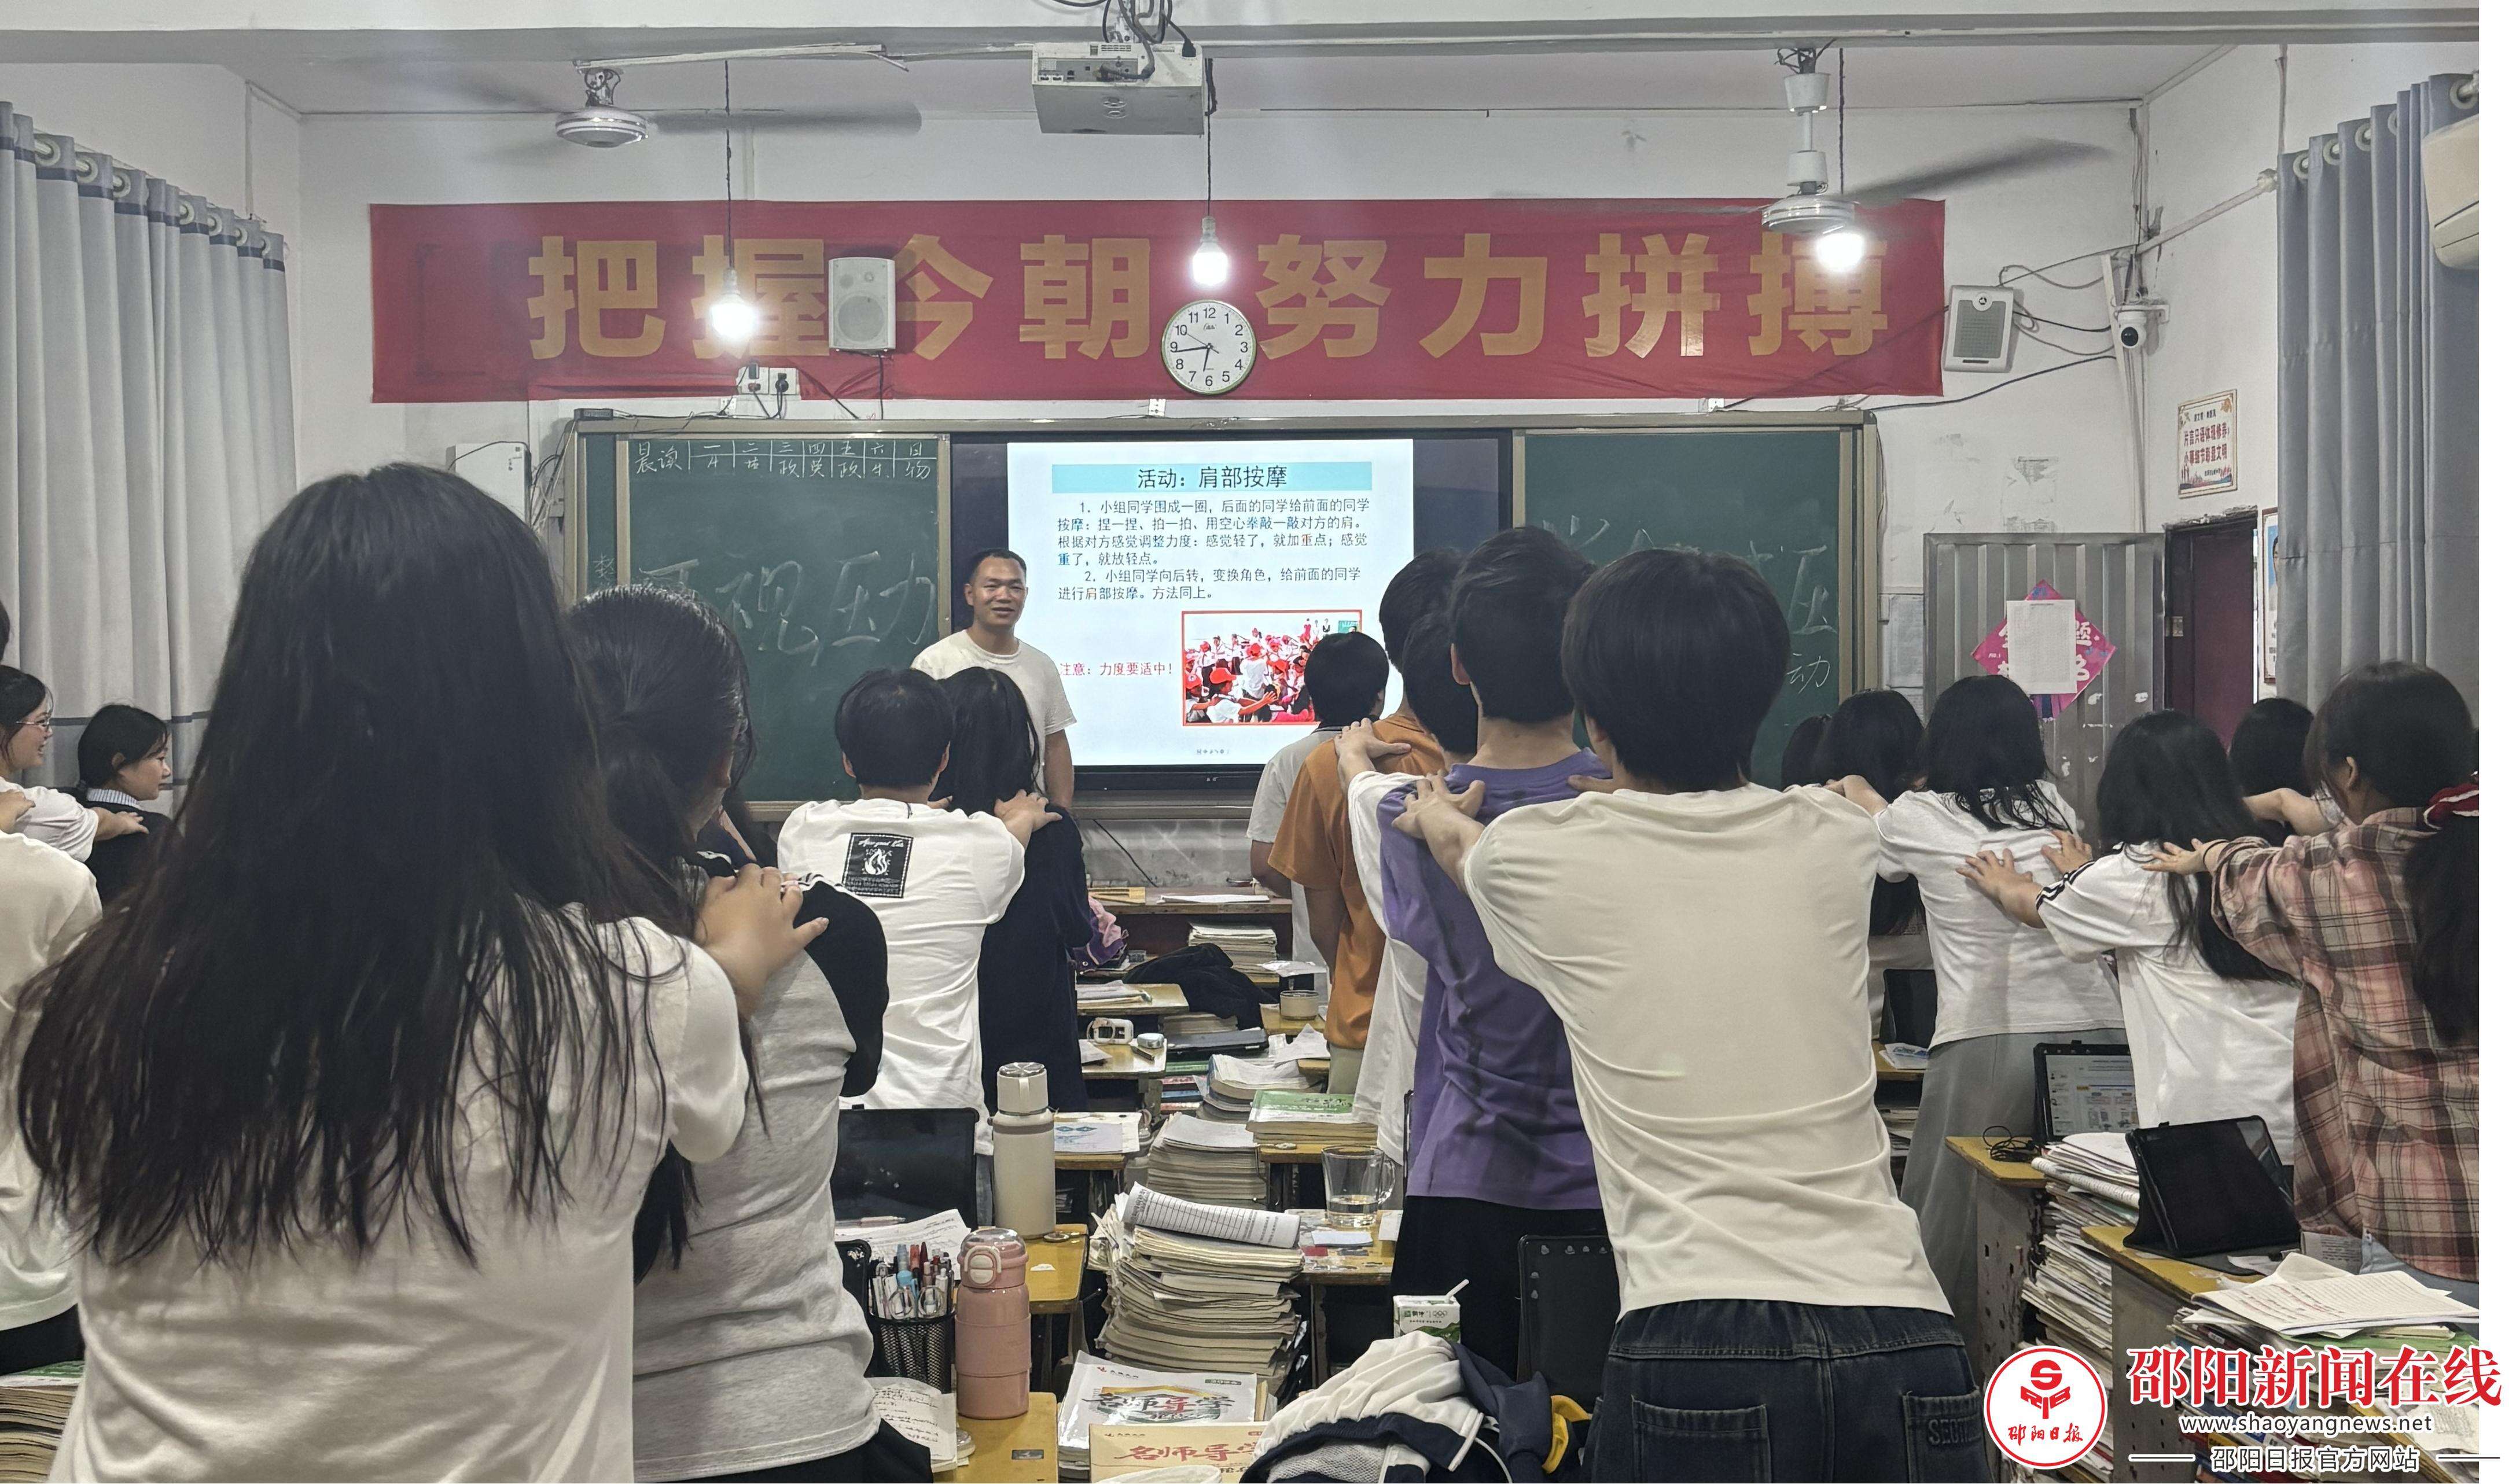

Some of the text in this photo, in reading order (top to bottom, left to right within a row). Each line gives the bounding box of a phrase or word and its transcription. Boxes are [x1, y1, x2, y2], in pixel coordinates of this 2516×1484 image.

[528, 233, 1888, 362] 把握今朝 努力拼搏
[1189, 312, 1198, 323] 11
[1204, 308, 1216, 318] 12
[1224, 313, 1229, 324] 1
[1176, 325, 1187, 336] 10
[1235, 325, 1243, 336] 2
[1170, 342, 1178, 352] 9
[1240, 342, 1248, 353] 3
[1176, 359, 1184, 369] 8
[1234, 359, 1242, 370] 4
[1189, 371, 1196, 382] 7
[1205, 375, 1212, 386] 6
[1222, 371, 1230, 382] 5
[742, 443, 759, 453] 二
[779, 442, 793, 452] 三
[809, 442, 825, 454] 四
[841, 441, 855, 455] 五
[871, 442, 884, 455] 六
[910, 442, 922, 456] 日
[635, 441, 682, 474] 晨读
[905, 461, 930, 479] 物
[1138, 465, 1287, 488] 活动：肩部按摩
[1058, 552, 1157, 566] 重了，就放轻点。
